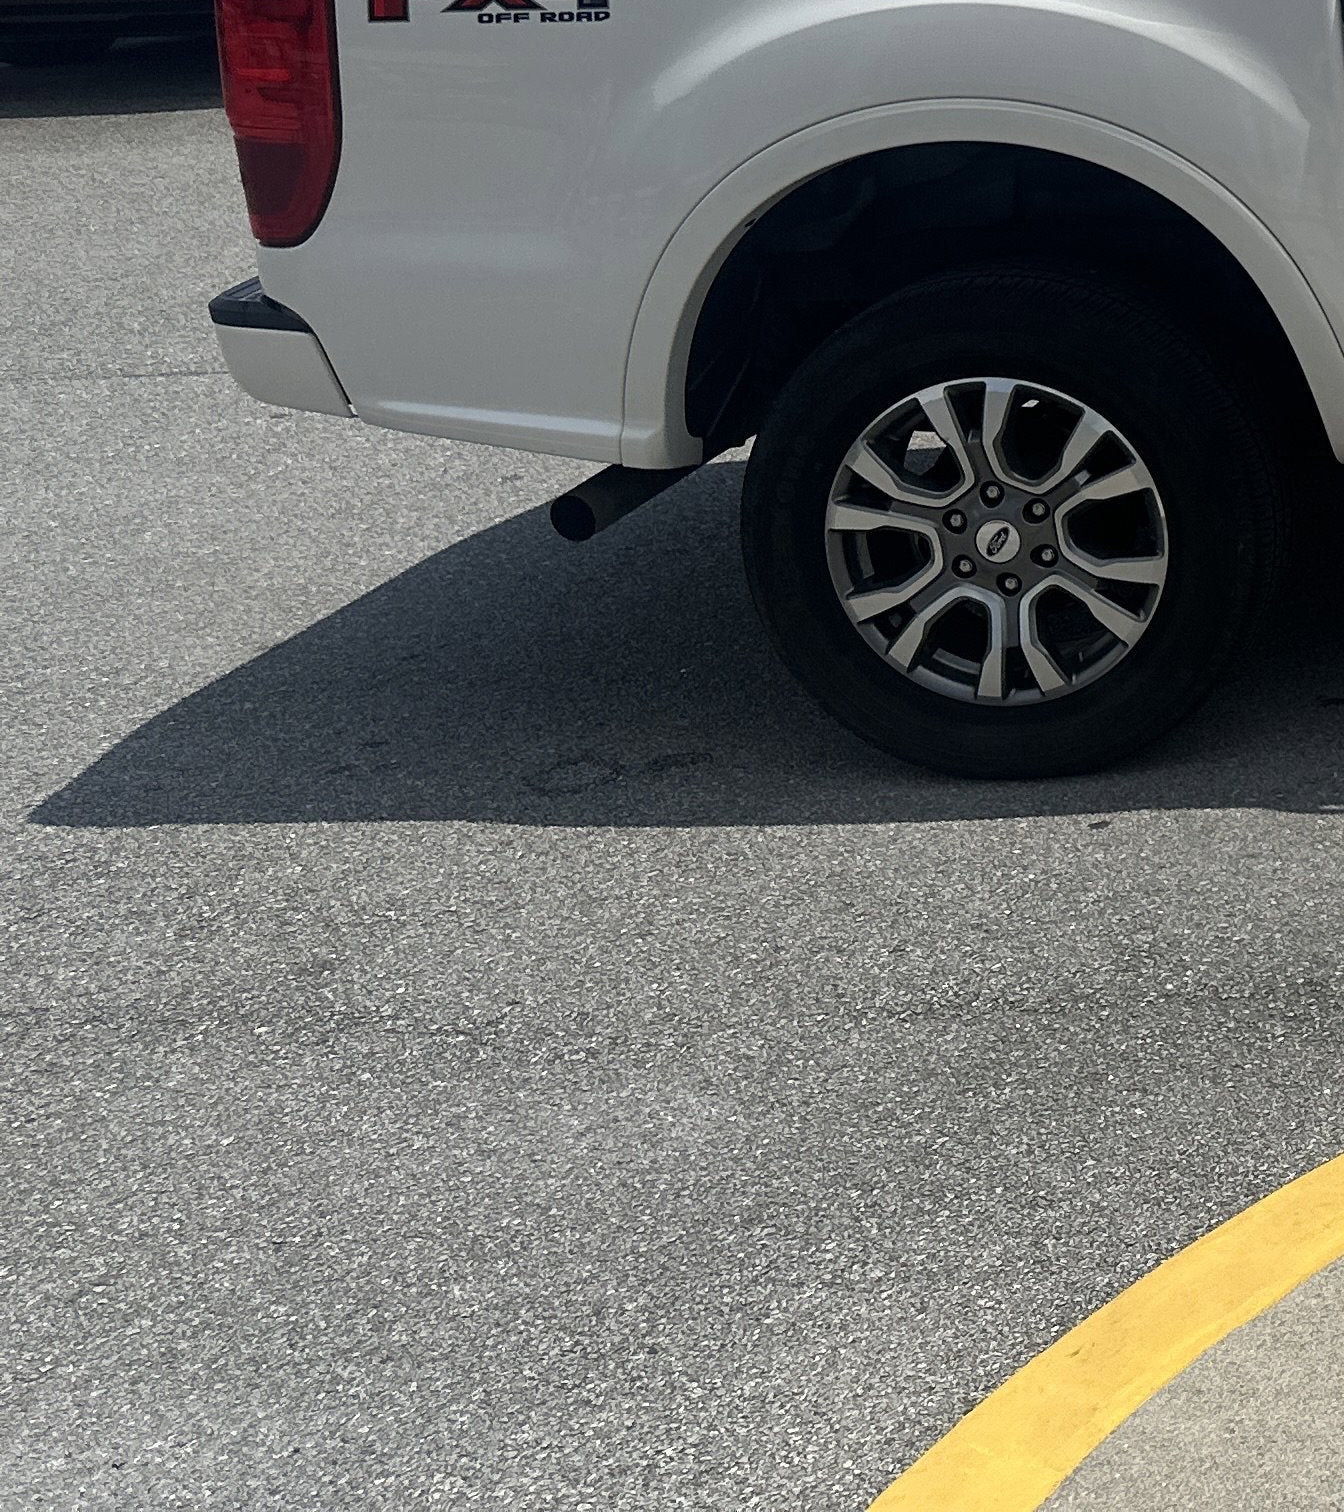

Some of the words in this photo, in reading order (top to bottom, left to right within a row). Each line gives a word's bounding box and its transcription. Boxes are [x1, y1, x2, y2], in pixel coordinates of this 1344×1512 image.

[477, 12, 530, 25] OFF
[540, 11, 611, 24] ROAD
[989, 530, 1008, 554] Ford
